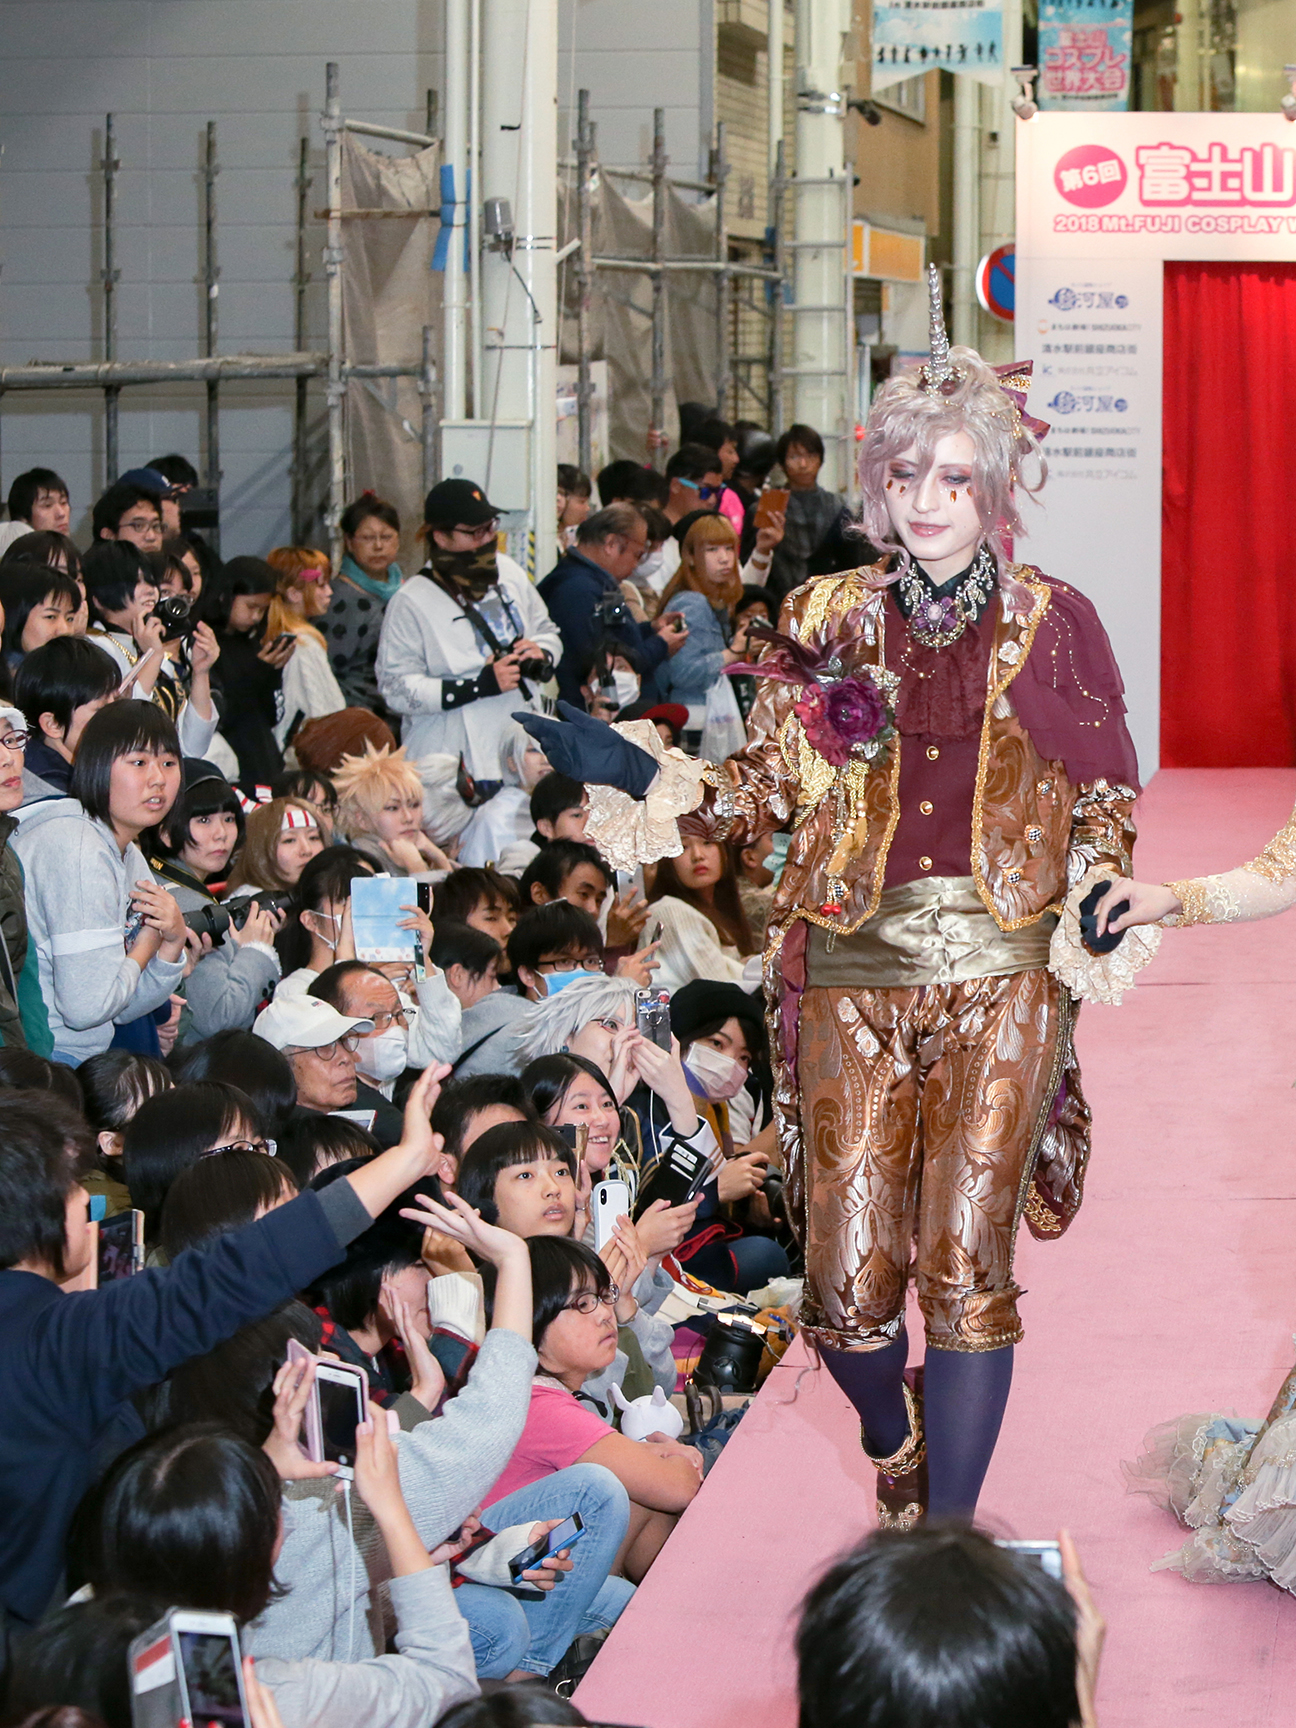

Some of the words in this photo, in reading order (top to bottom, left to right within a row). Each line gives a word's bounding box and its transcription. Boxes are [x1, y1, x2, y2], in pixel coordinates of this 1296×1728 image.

[1059, 158, 1122, 193] 第6回
[1054, 216, 1100, 233] 2018
[1186, 215, 1283, 235] COSPLAY
